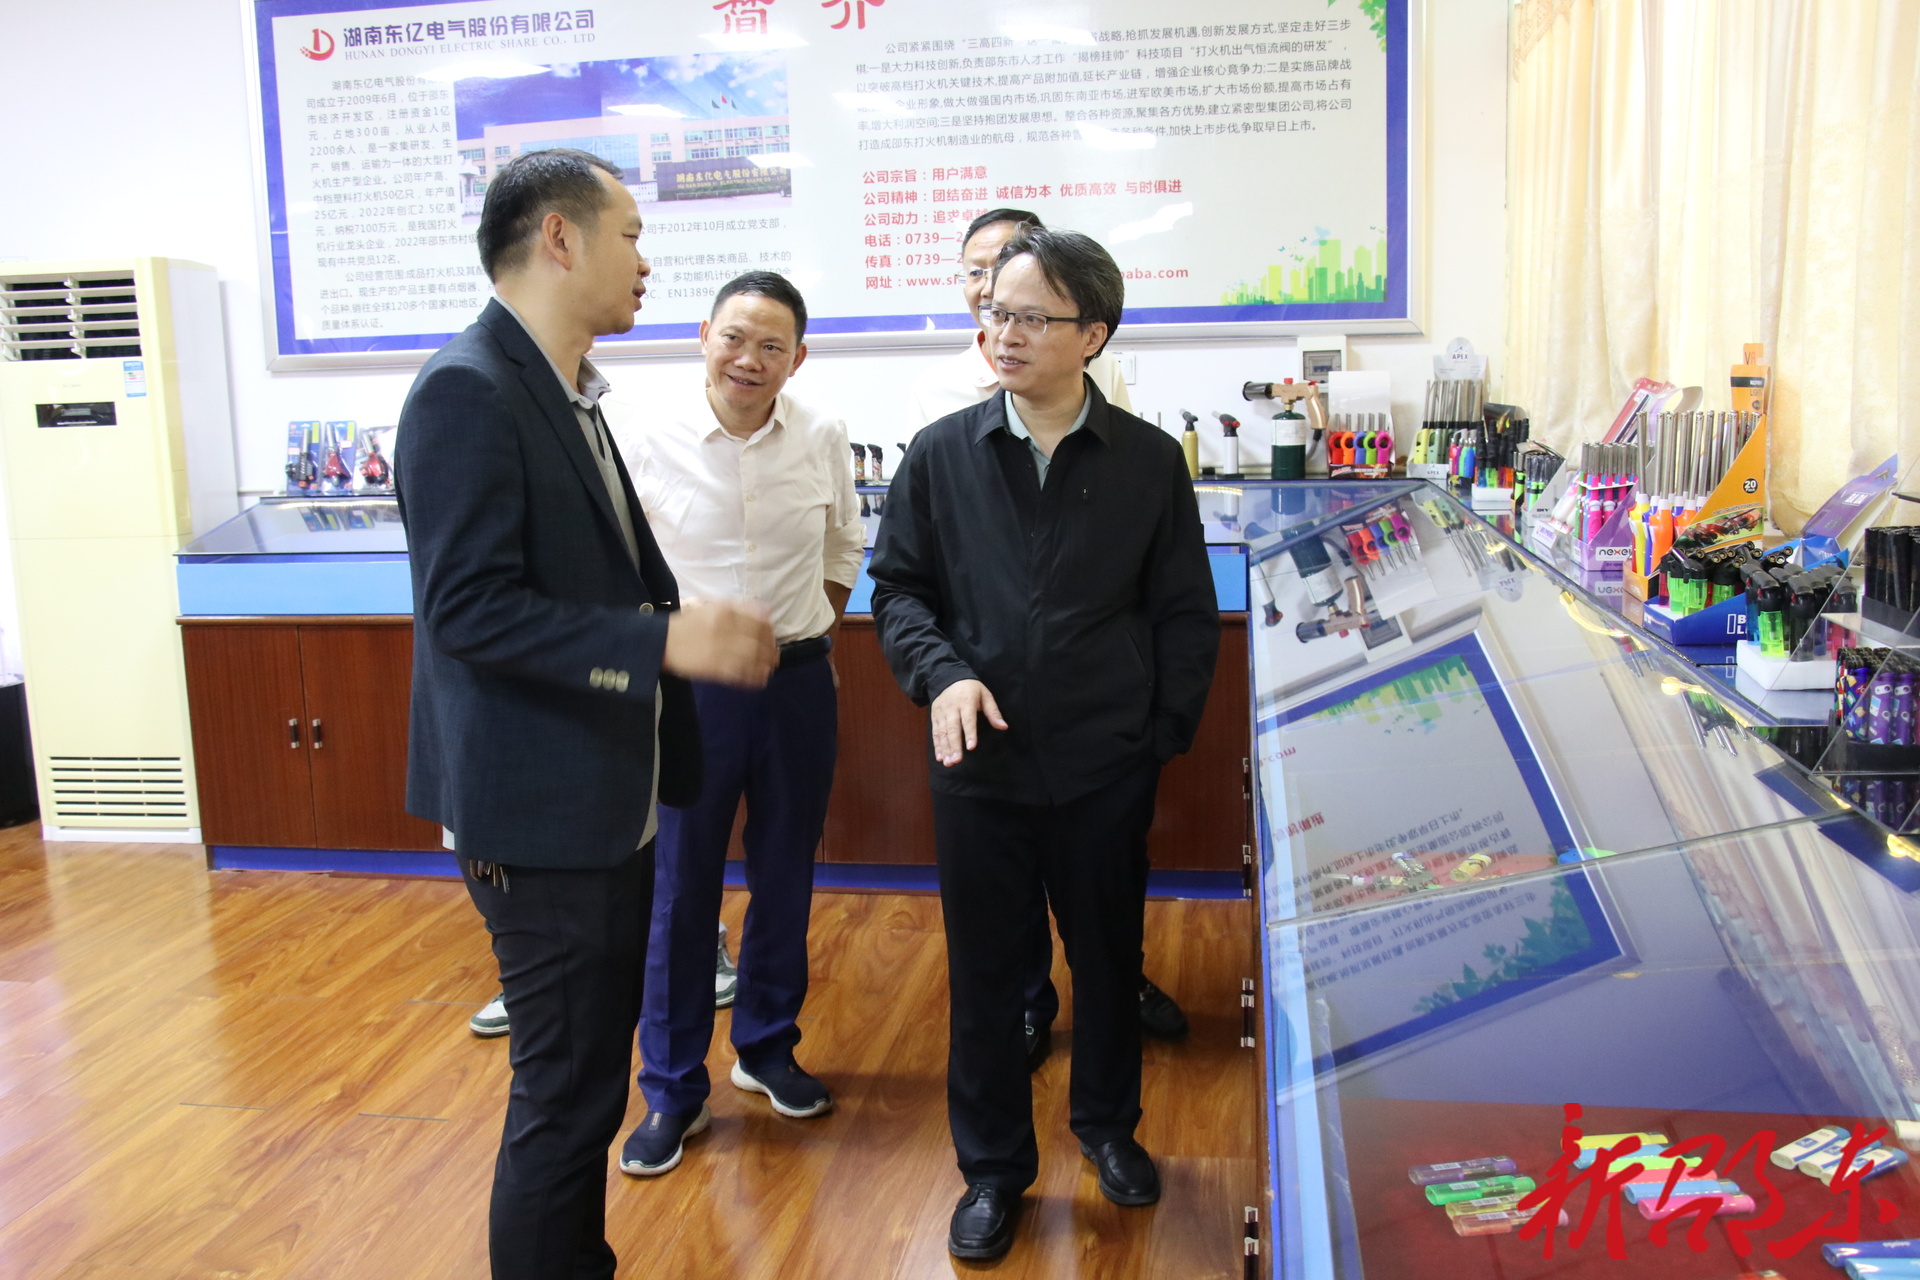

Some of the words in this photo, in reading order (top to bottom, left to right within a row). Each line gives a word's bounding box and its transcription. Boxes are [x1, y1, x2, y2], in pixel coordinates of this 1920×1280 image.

[343, 9, 595, 48] 湖南东亿电气股份有限公司
[345, 49, 385, 61] HUNAN
[390, 45, 435, 58] DONGYI
[440, 40, 496, 54] ELECTRIC
[500, 36, 539, 49] SHARE
[573, 32, 596, 44] LTD
[332, 75, 438, 91] 湖南东亿电气股份有
[995, 184, 1052, 199] 诚信为本
[1060, 182, 1117, 197] 优质高效
[1125, 179, 1182, 194] 与时俱进
[1744, 480, 1757, 489] 20
